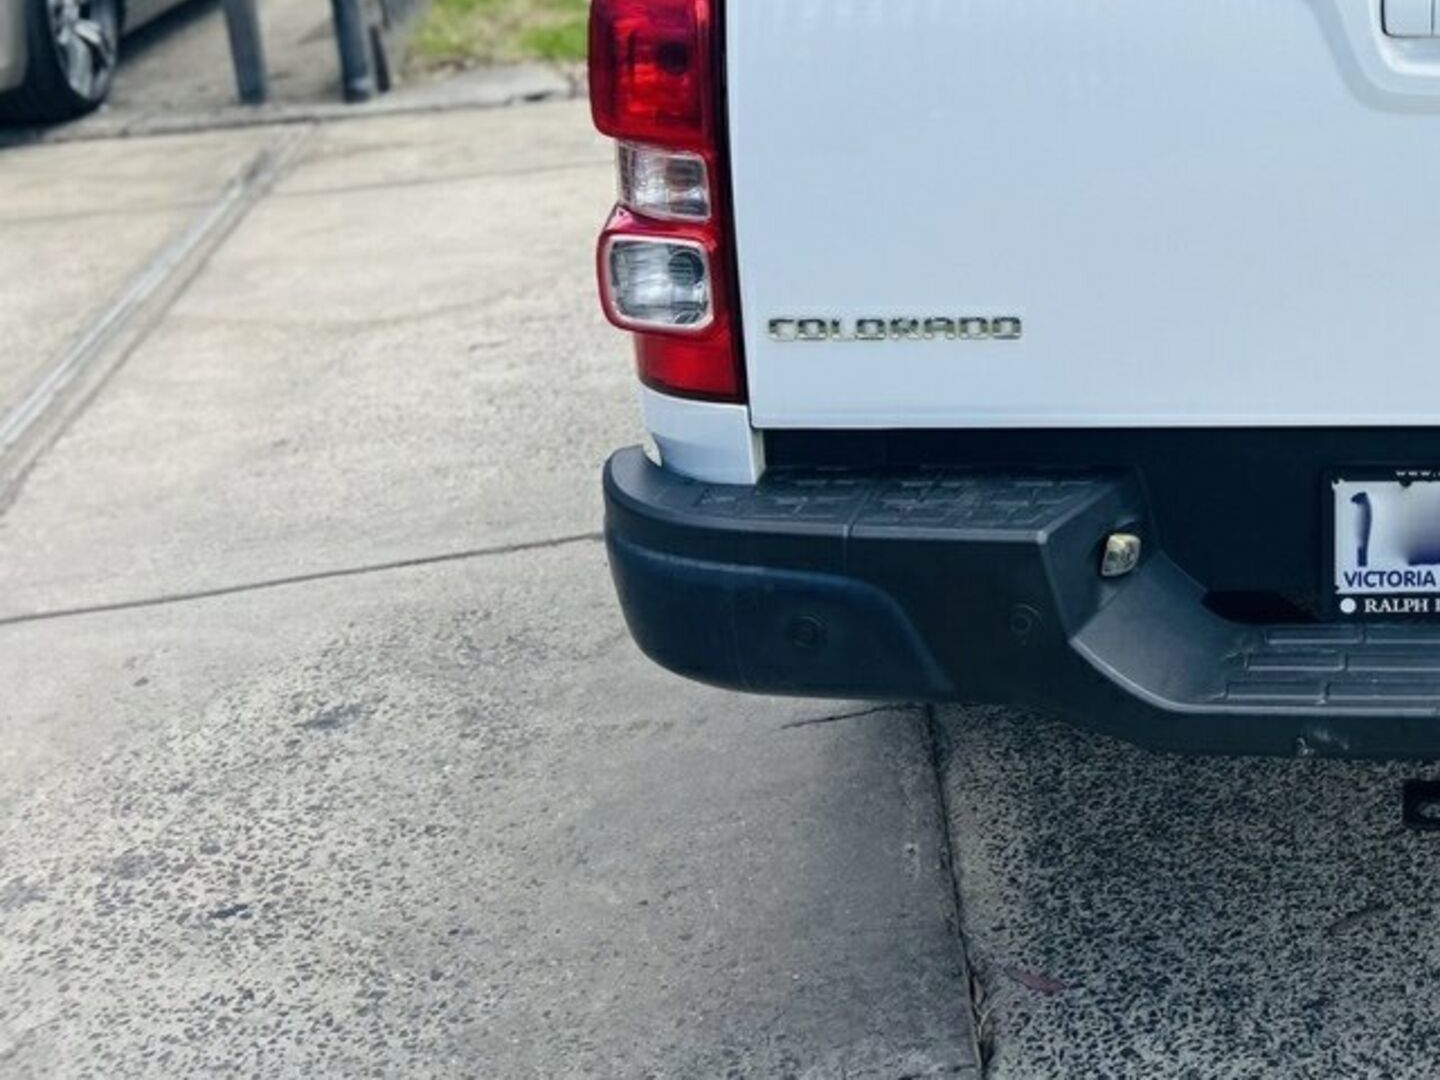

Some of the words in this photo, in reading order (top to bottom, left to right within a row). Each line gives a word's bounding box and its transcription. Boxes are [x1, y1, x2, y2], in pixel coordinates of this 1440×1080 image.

[768, 316, 1022, 341] COLORADO
[1343, 570, 1437, 588] VICTORIA
[1363, 597, 1429, 613] RALPH
